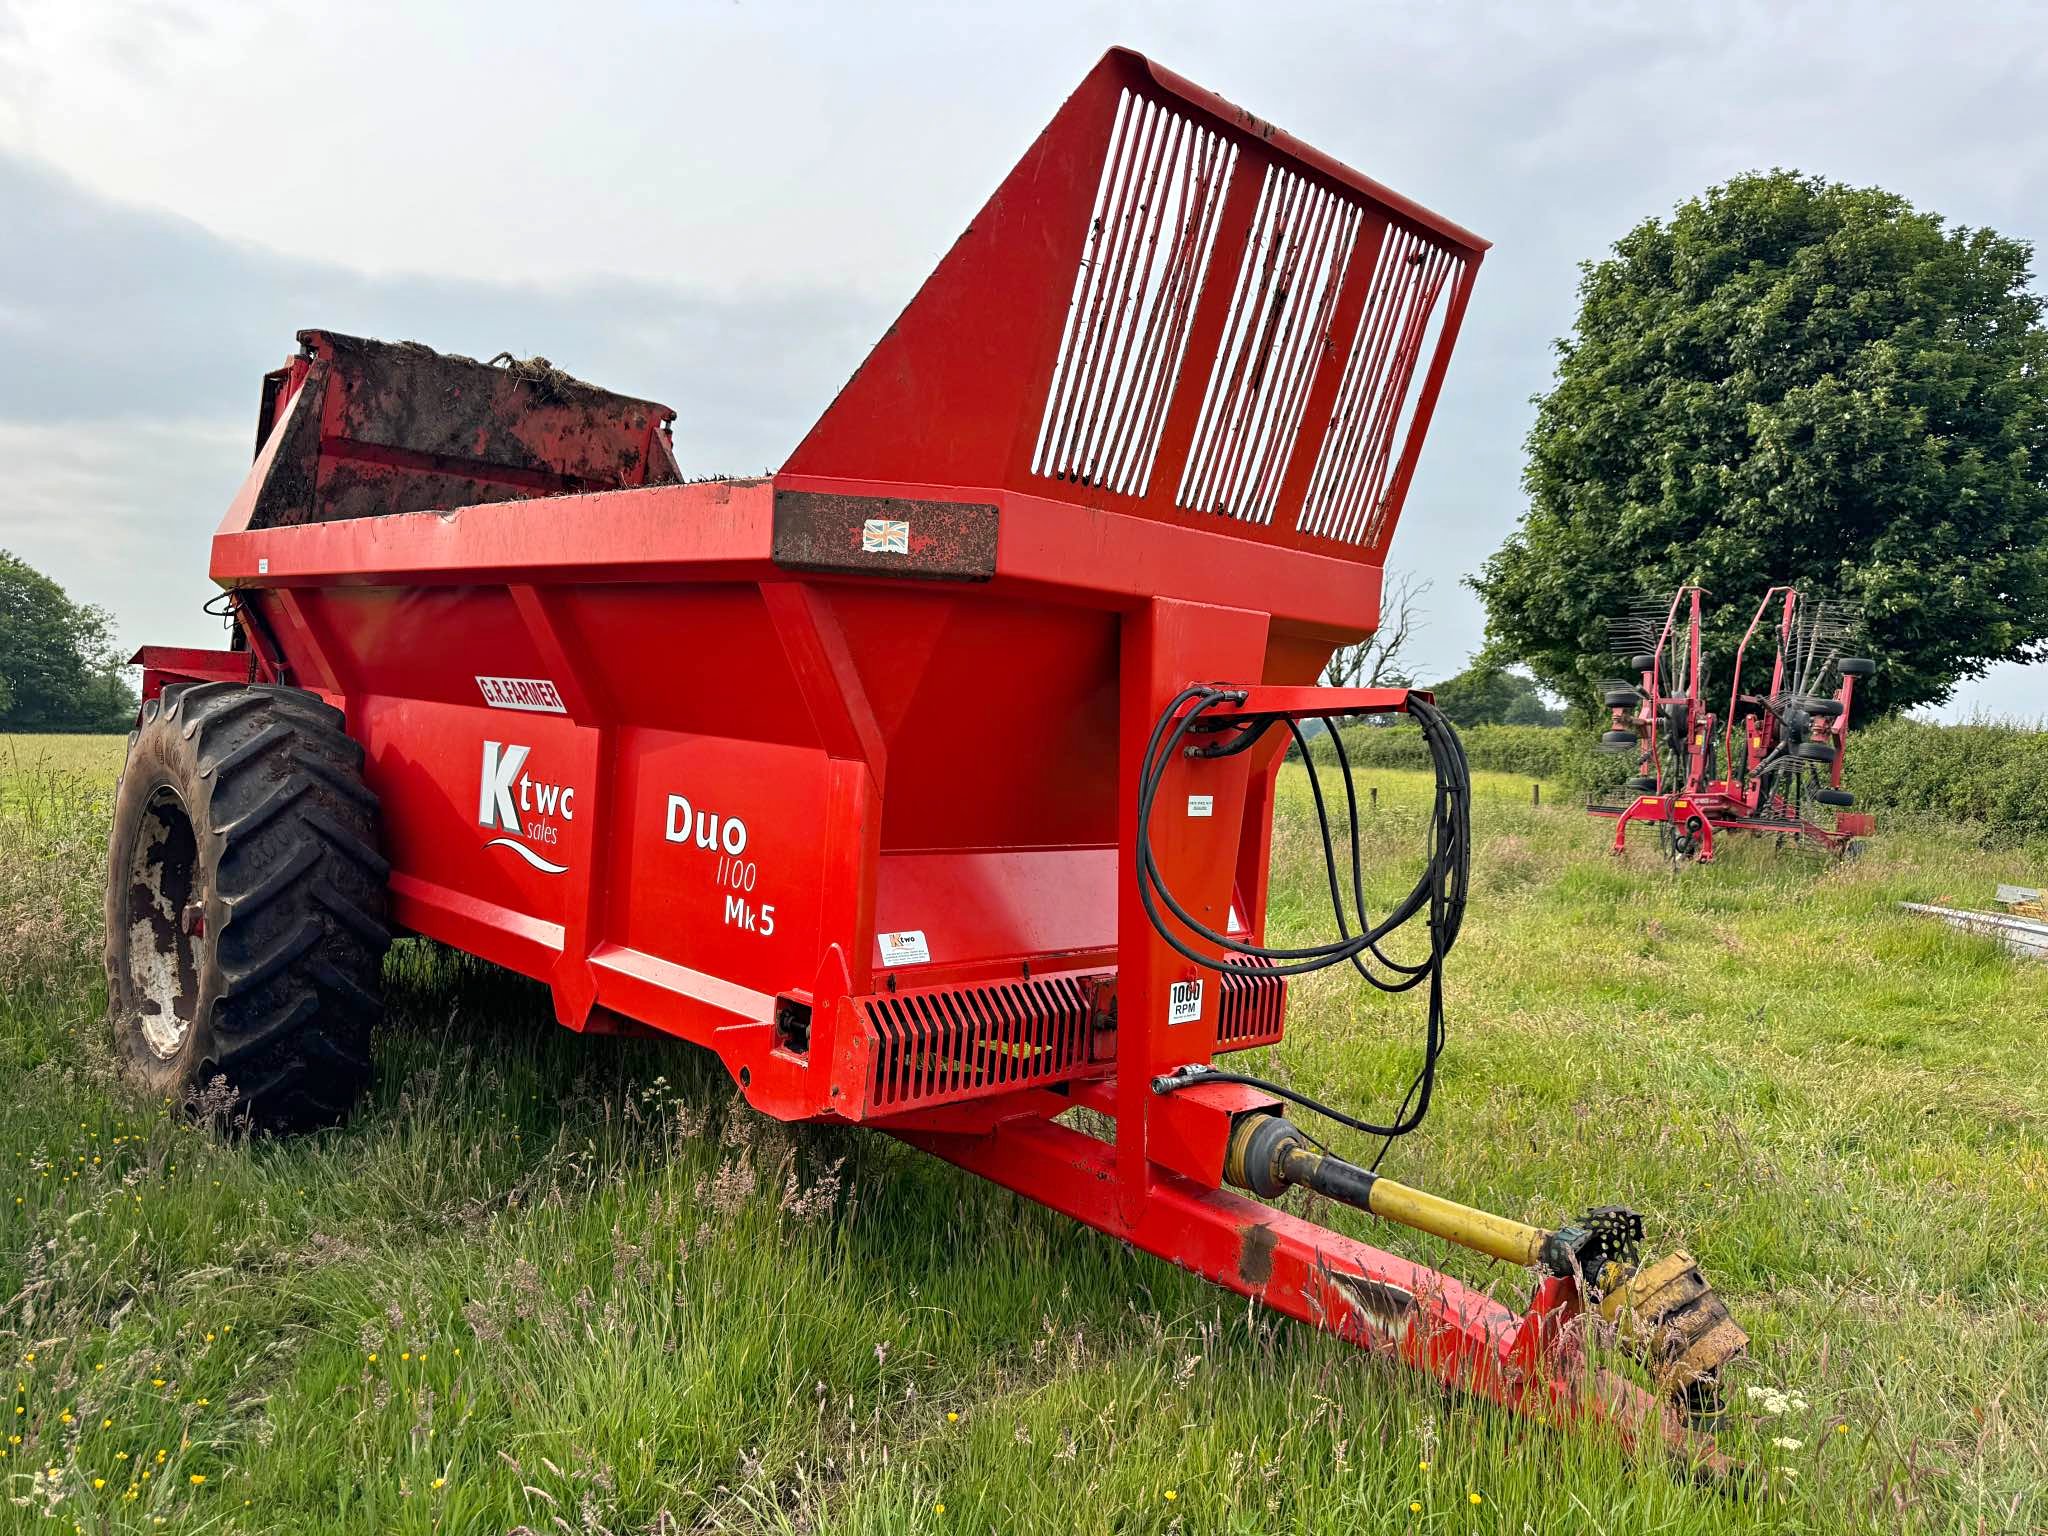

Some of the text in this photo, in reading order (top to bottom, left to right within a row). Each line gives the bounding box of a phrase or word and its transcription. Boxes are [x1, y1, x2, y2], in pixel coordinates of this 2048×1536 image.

[527, 817, 558, 844] sales
[665, 792, 748, 856] Duo
[716, 855, 756, 892] 1100
[1173, 982, 1201, 1004] 1000
[1175, 1002, 1196, 1015] RPM
